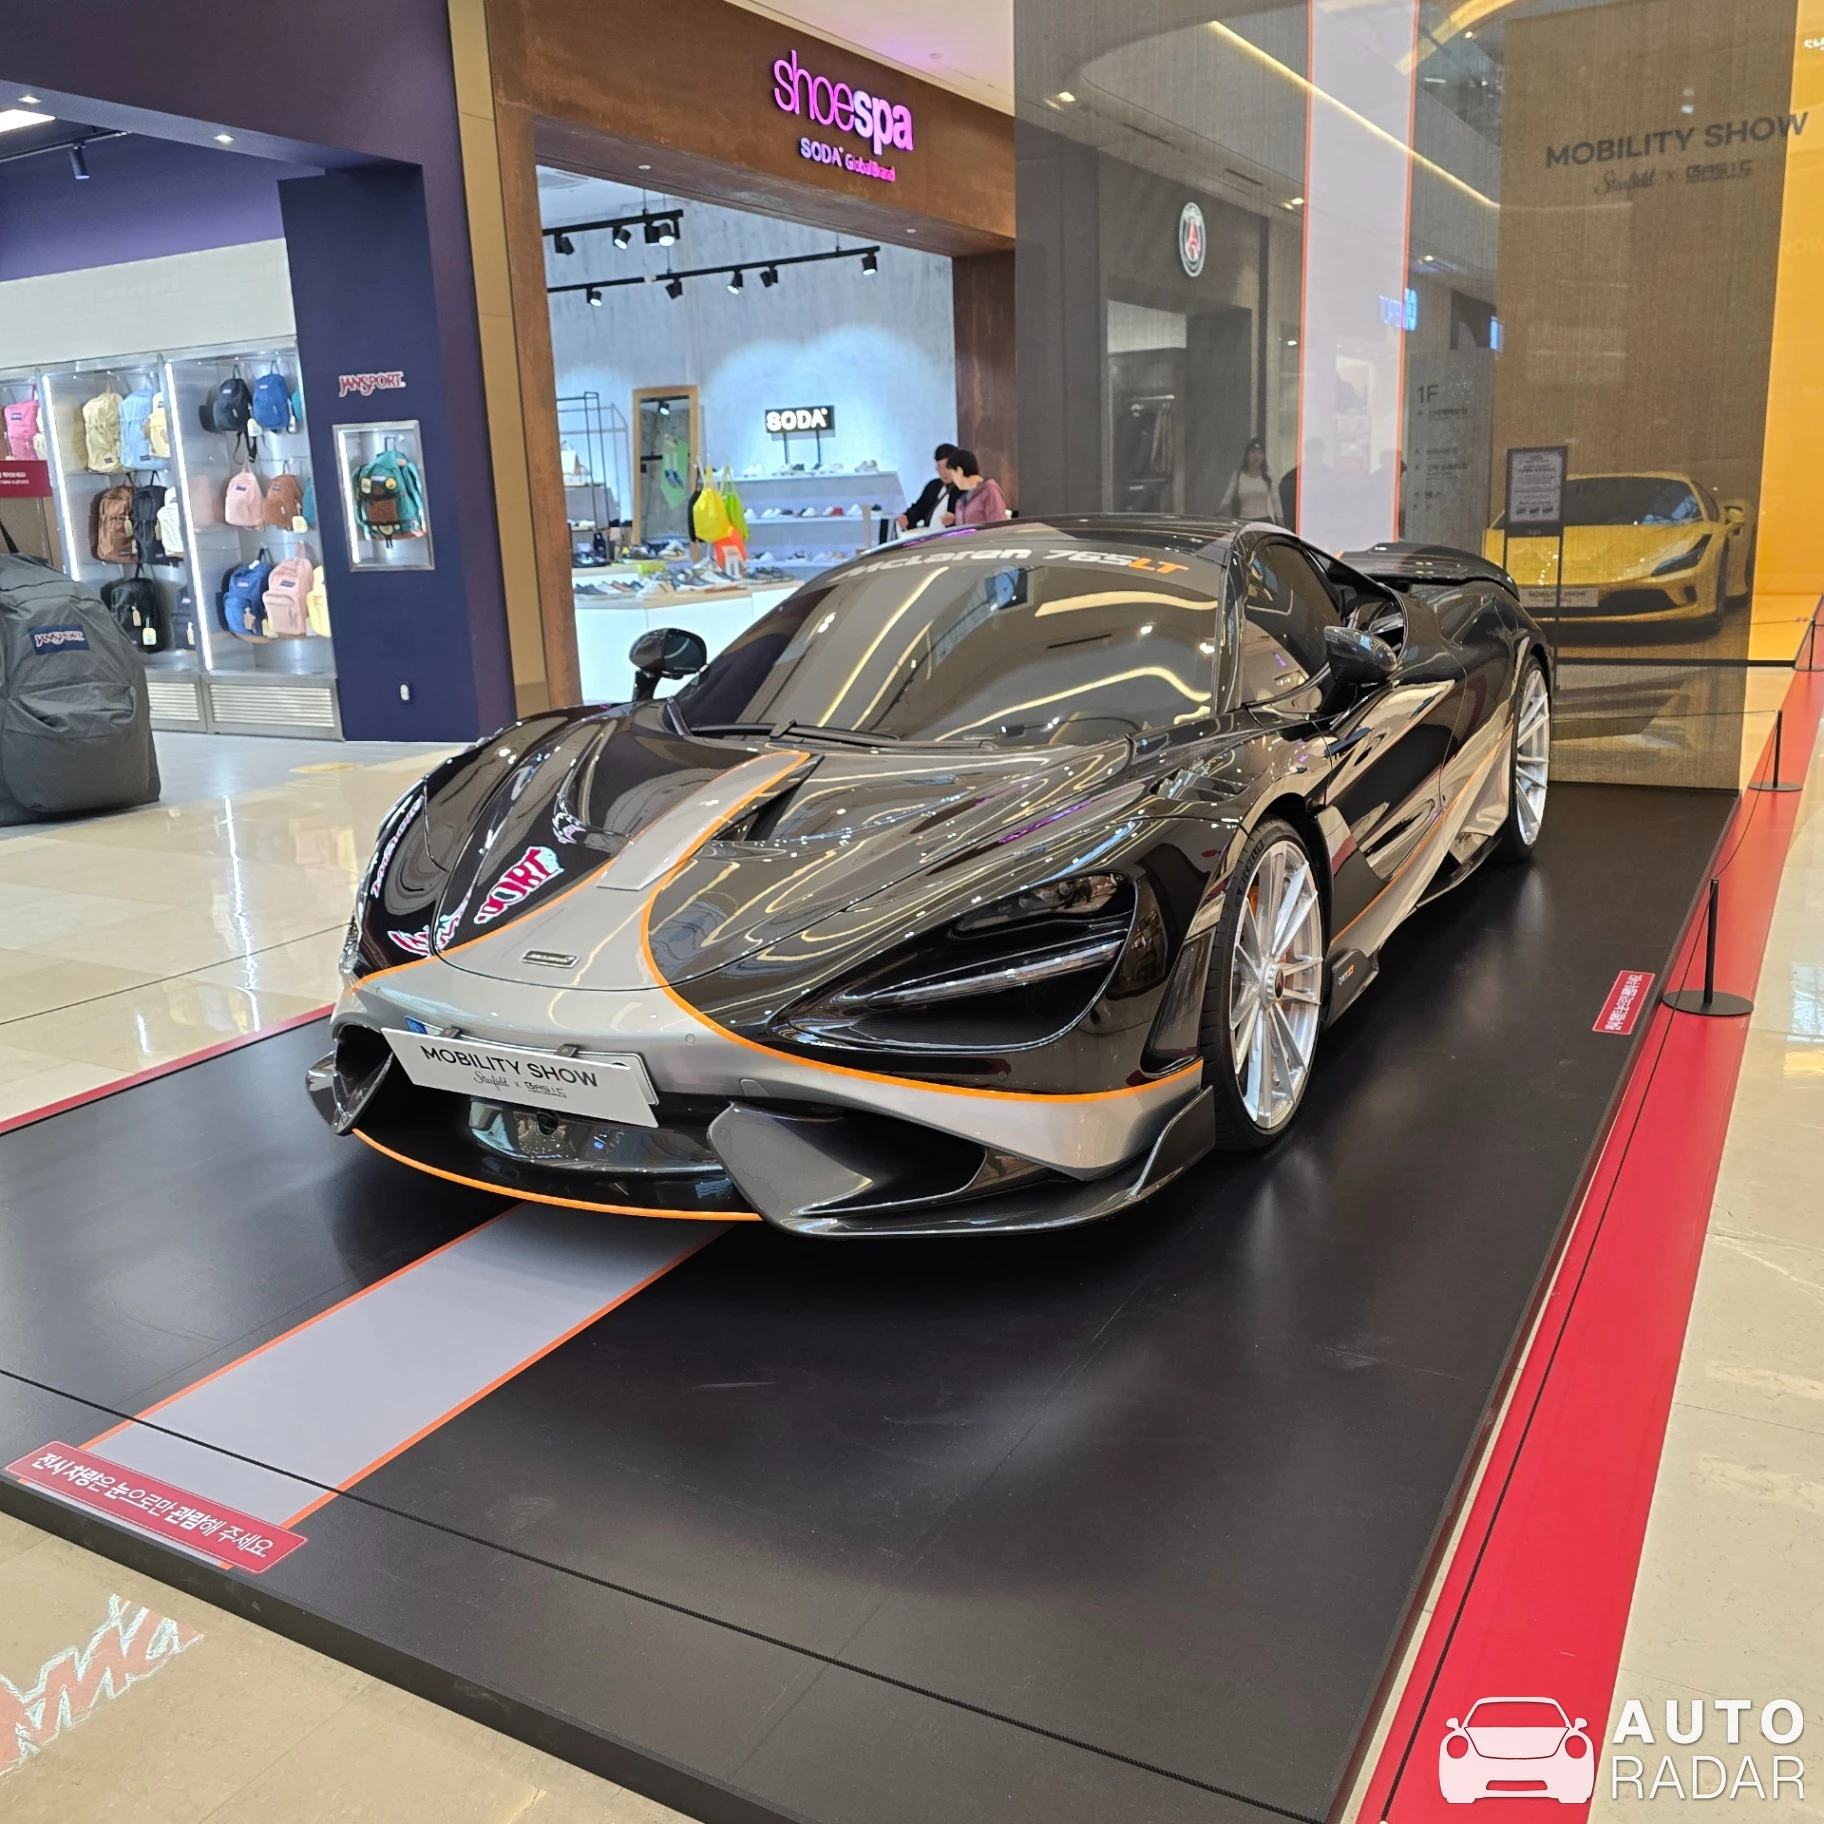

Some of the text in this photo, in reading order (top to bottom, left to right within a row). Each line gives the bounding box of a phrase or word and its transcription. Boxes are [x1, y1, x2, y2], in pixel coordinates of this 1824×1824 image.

[773, 49, 914, 156] shoespa
[800, 137, 842, 168] SODA
[1545, 112, 1809, 169] MOBILITY SHOW
[338, 371, 406, 398] JANSPORT
[1417, 384, 1440, 404] 1F
[766, 407, 828, 432] SODA
[1042, 549, 1190, 574] 765LT
[420, 1045, 599, 1087] MOBILITY SHOW
[31, 1452, 274, 1558] 전시 차량은 눈으로만 관람해 주세요.
